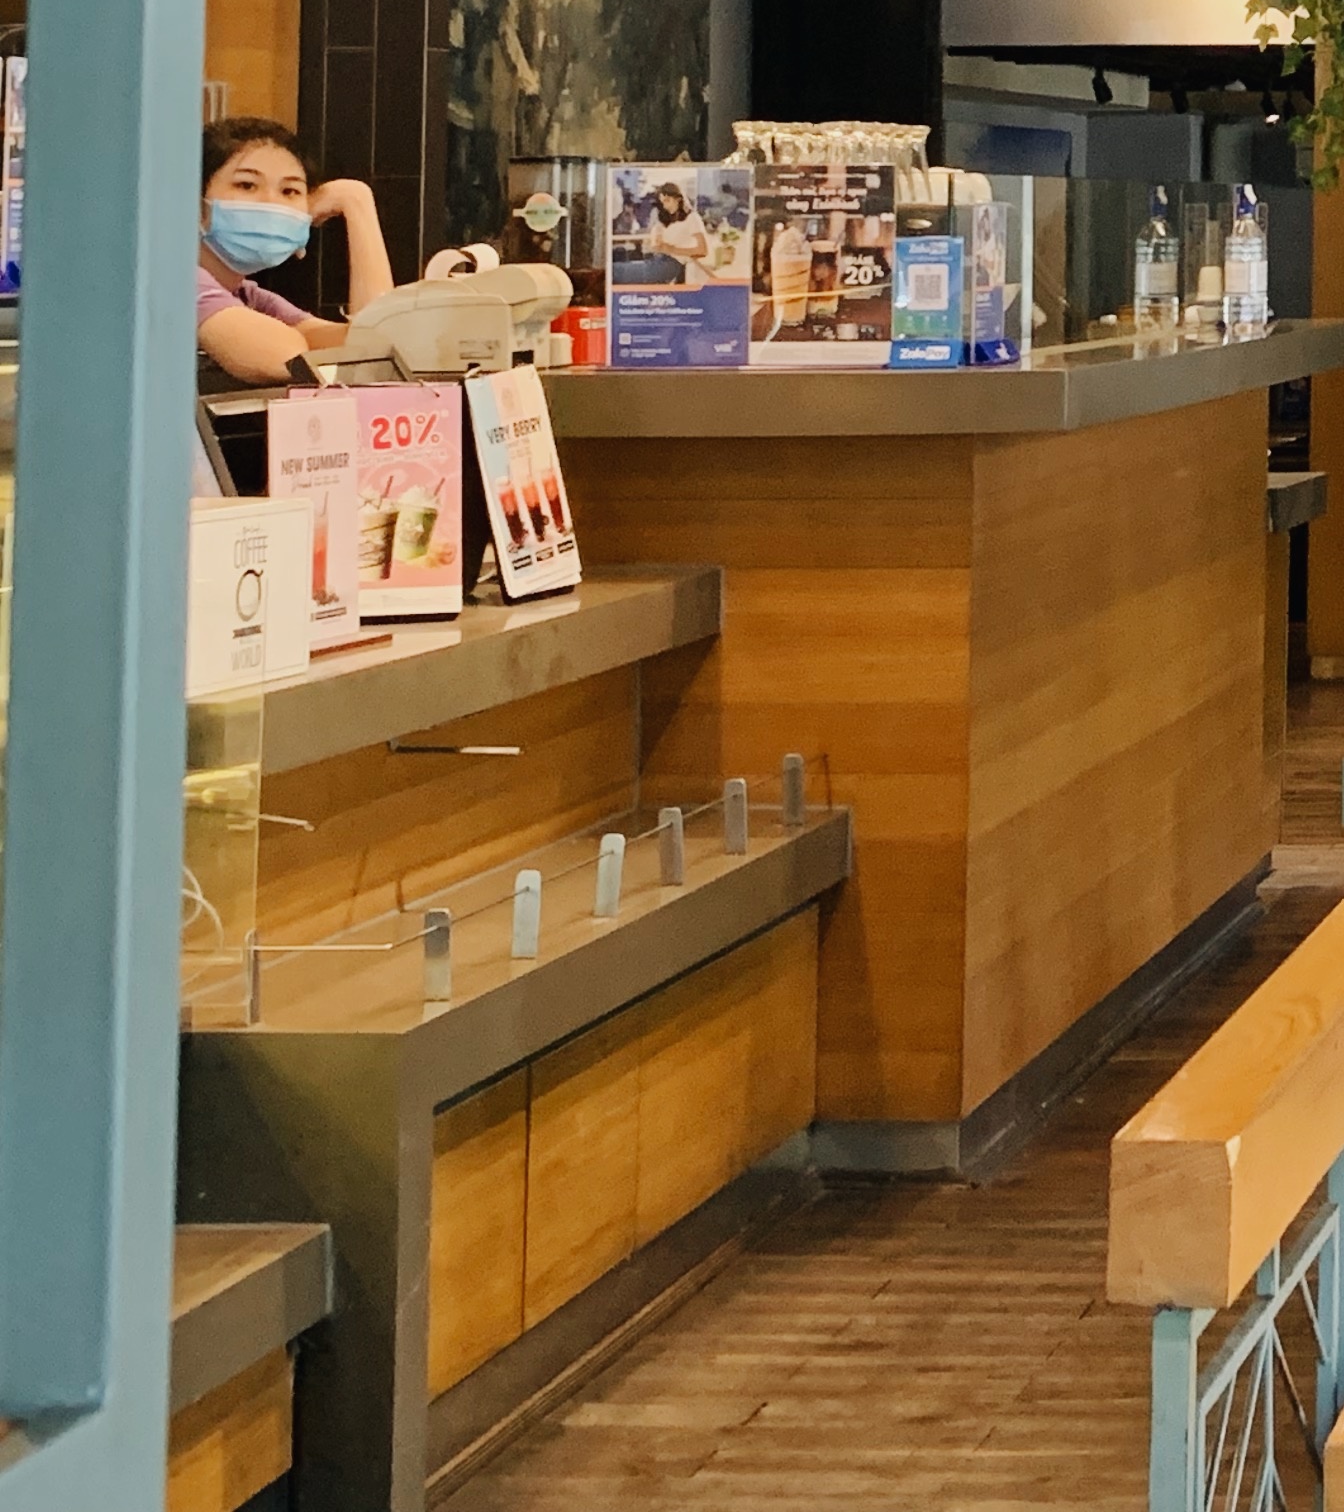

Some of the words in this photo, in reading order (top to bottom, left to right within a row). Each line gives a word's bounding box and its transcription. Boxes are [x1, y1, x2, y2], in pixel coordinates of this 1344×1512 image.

[844, 265, 884, 285] 20%
[370, 413, 440, 450] 20%
[485, 424, 510, 445] VERY
[512, 415, 542, 437] BERRY
[281, 457, 304, 476] NEW
[306, 452, 350, 473] SUMMER
[233, 535, 268, 569] COFFEE
